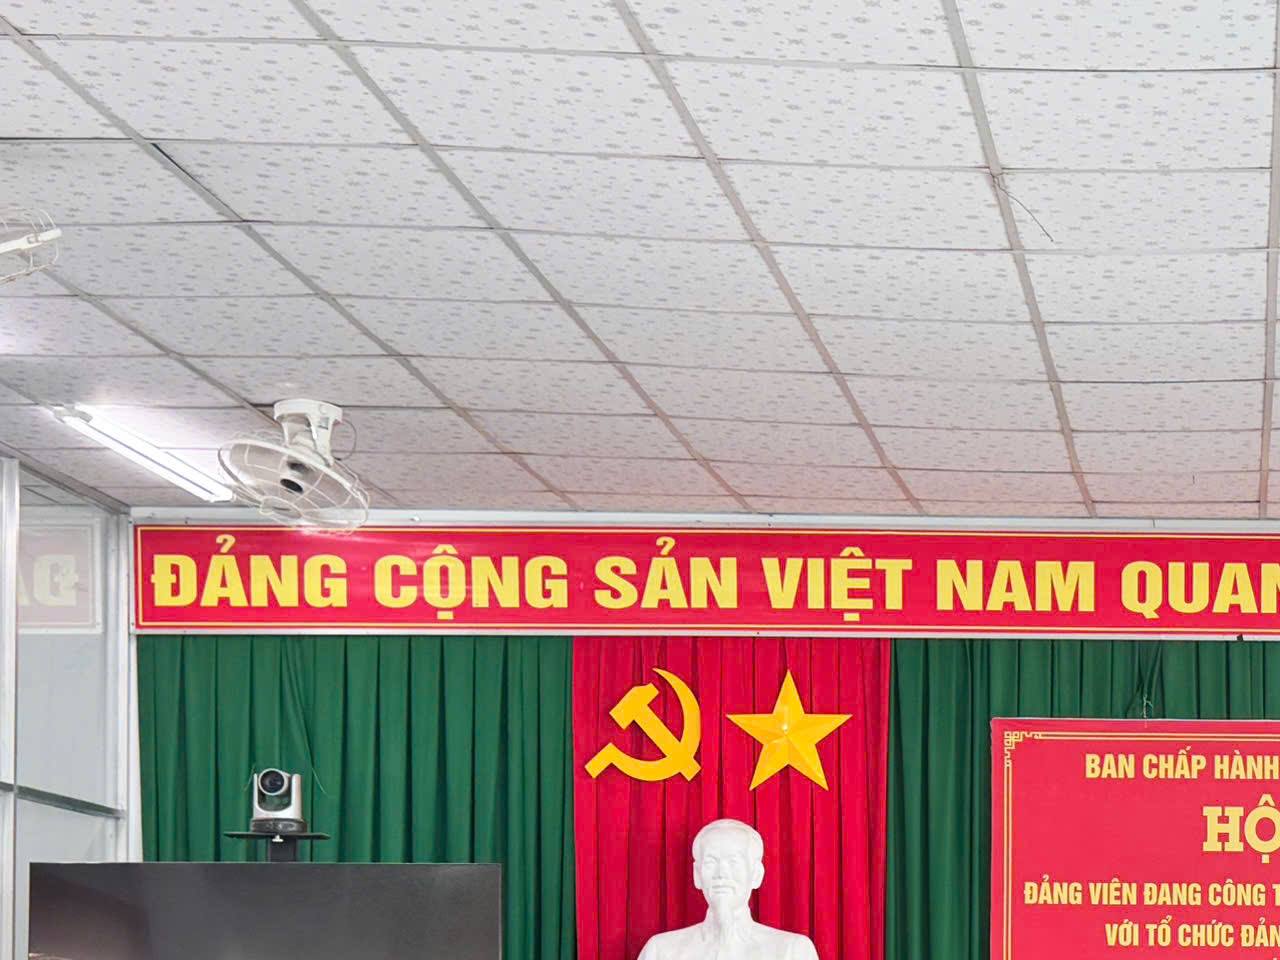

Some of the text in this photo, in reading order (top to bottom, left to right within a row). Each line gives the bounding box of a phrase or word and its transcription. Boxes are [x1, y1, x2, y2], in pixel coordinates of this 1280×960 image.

[150, 534, 348, 608] ĐẢNG
[374, 544, 568, 620] CỘNG
[594, 536, 738, 609] SẢN
[761, 546, 913, 622] VIỆT
[936, 560, 1095, 612] NAM
[1085, 753, 1135, 779] BAN
[1142, 746, 1207, 779] CHẤP
[1214, 749, 1280, 780] HÀNH
[1023, 875, 1083, 905] ĐẢNG
[1089, 877, 1137, 905] VIÊN
[1143, 882, 1202, 906] ĐANG
[1208, 878, 1266, 907] CÔNG
[1105, 918, 1139, 947] VỚI
[1145, 914, 1173, 947] TỔ
[1178, 919, 1234, 947] CHỨC
